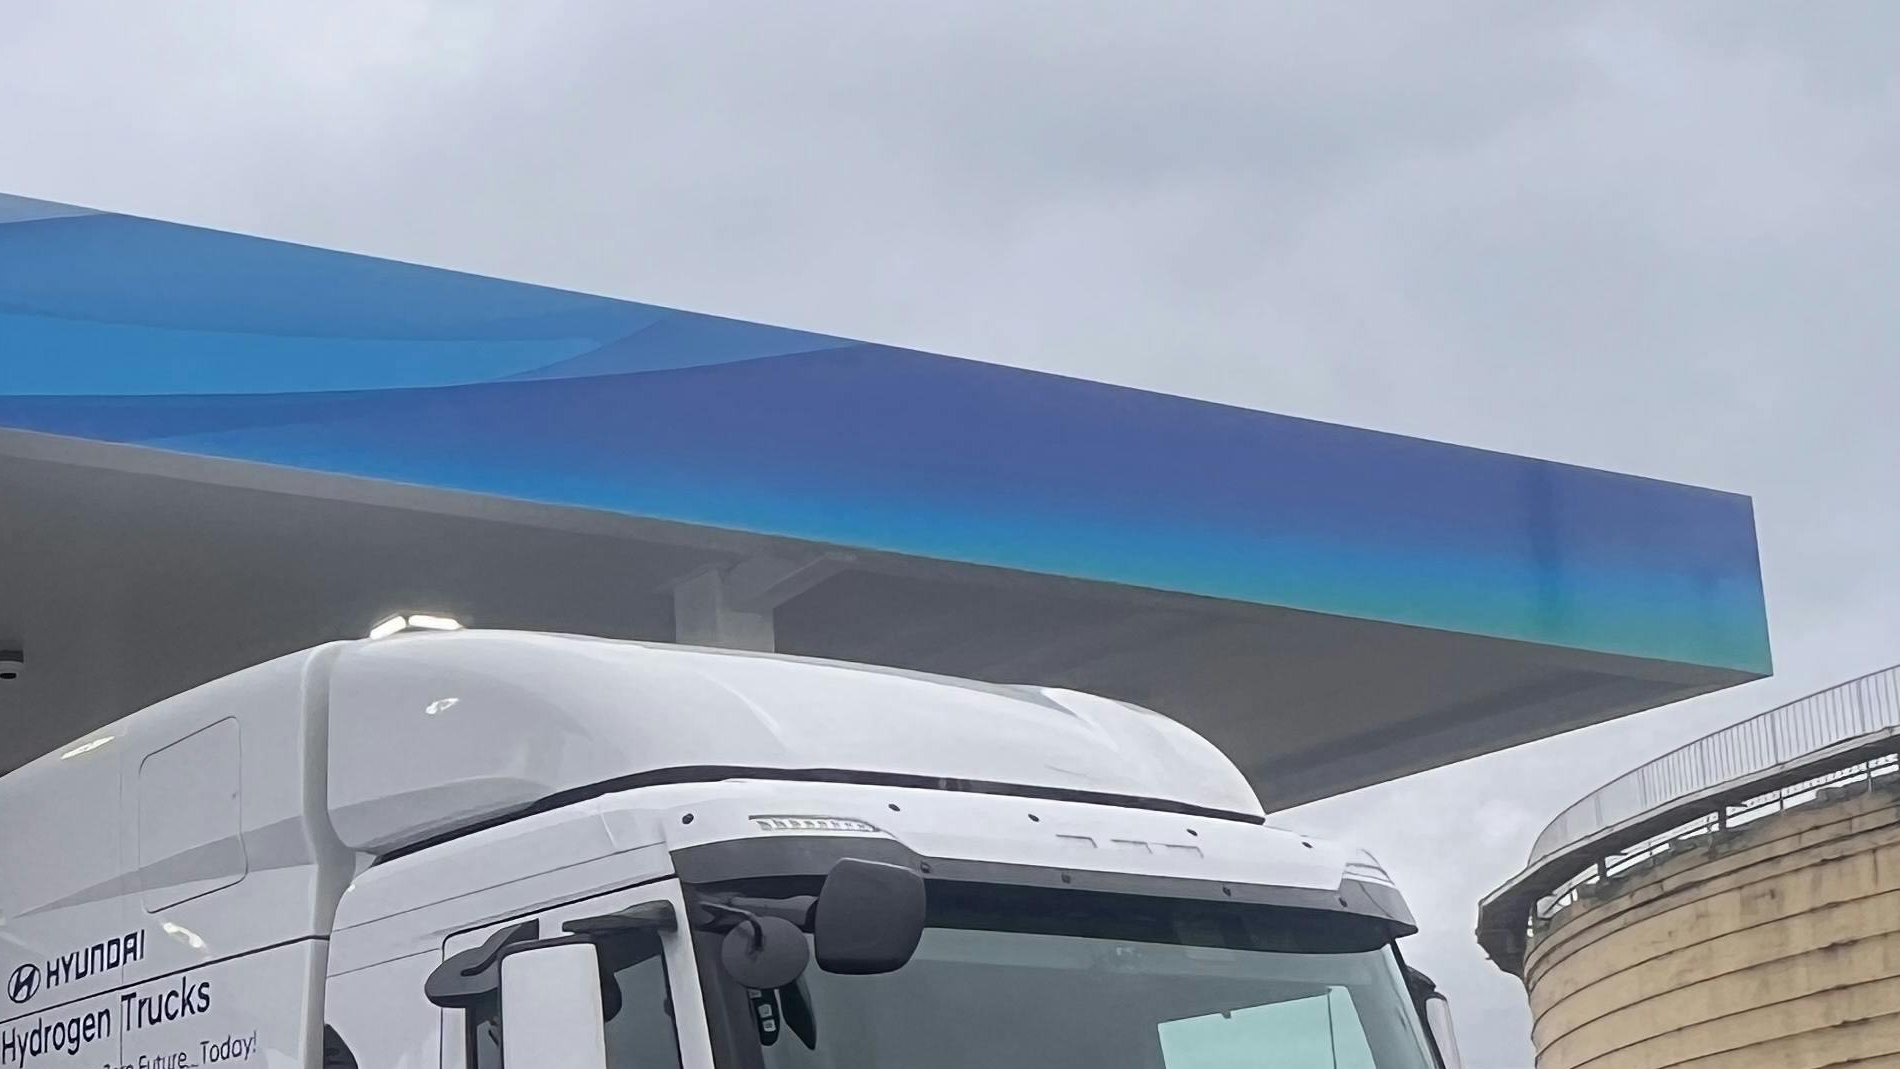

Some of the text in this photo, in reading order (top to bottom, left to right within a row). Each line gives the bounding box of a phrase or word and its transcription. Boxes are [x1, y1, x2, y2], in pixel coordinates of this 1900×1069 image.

[44, 929, 146, 989] HYUNDAI
[1, 975, 211, 1069] Hydrogen Trucks
